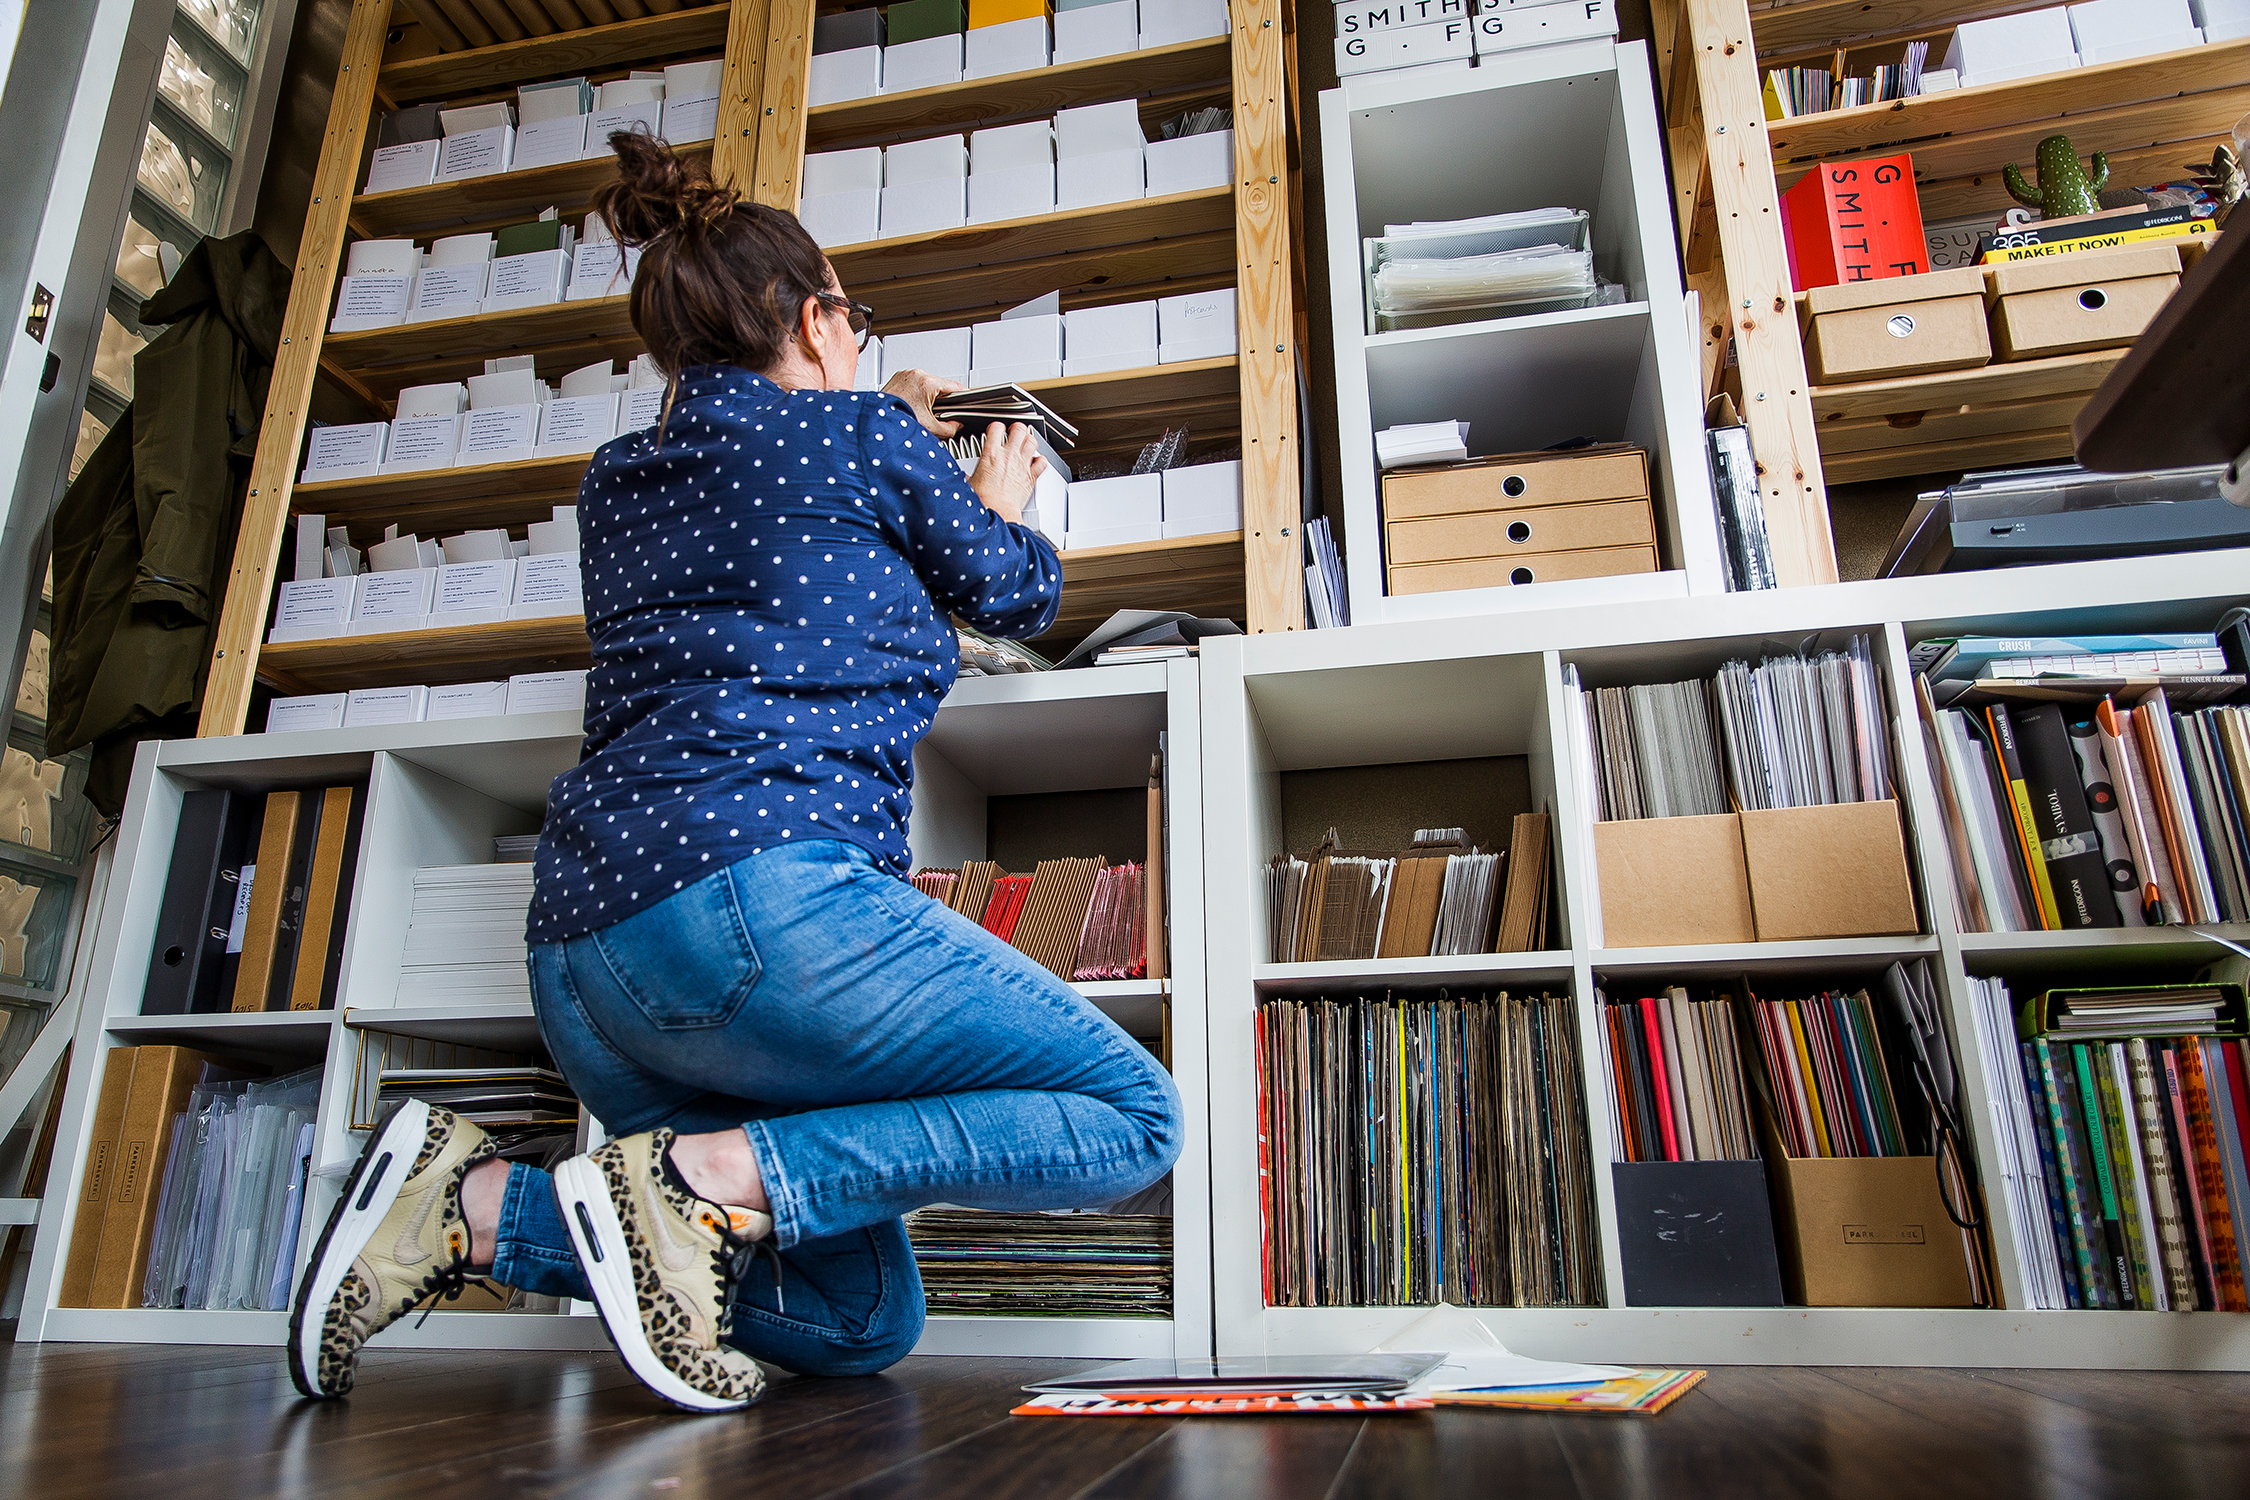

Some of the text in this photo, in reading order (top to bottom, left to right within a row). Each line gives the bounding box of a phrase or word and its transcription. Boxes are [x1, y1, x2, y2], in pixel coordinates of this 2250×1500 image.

[1832, 169, 1873, 282] SMITH
[2007, 236, 2126, 261] MAKE IT NOW!
[1998, 641, 2031, 651] CRUSH
